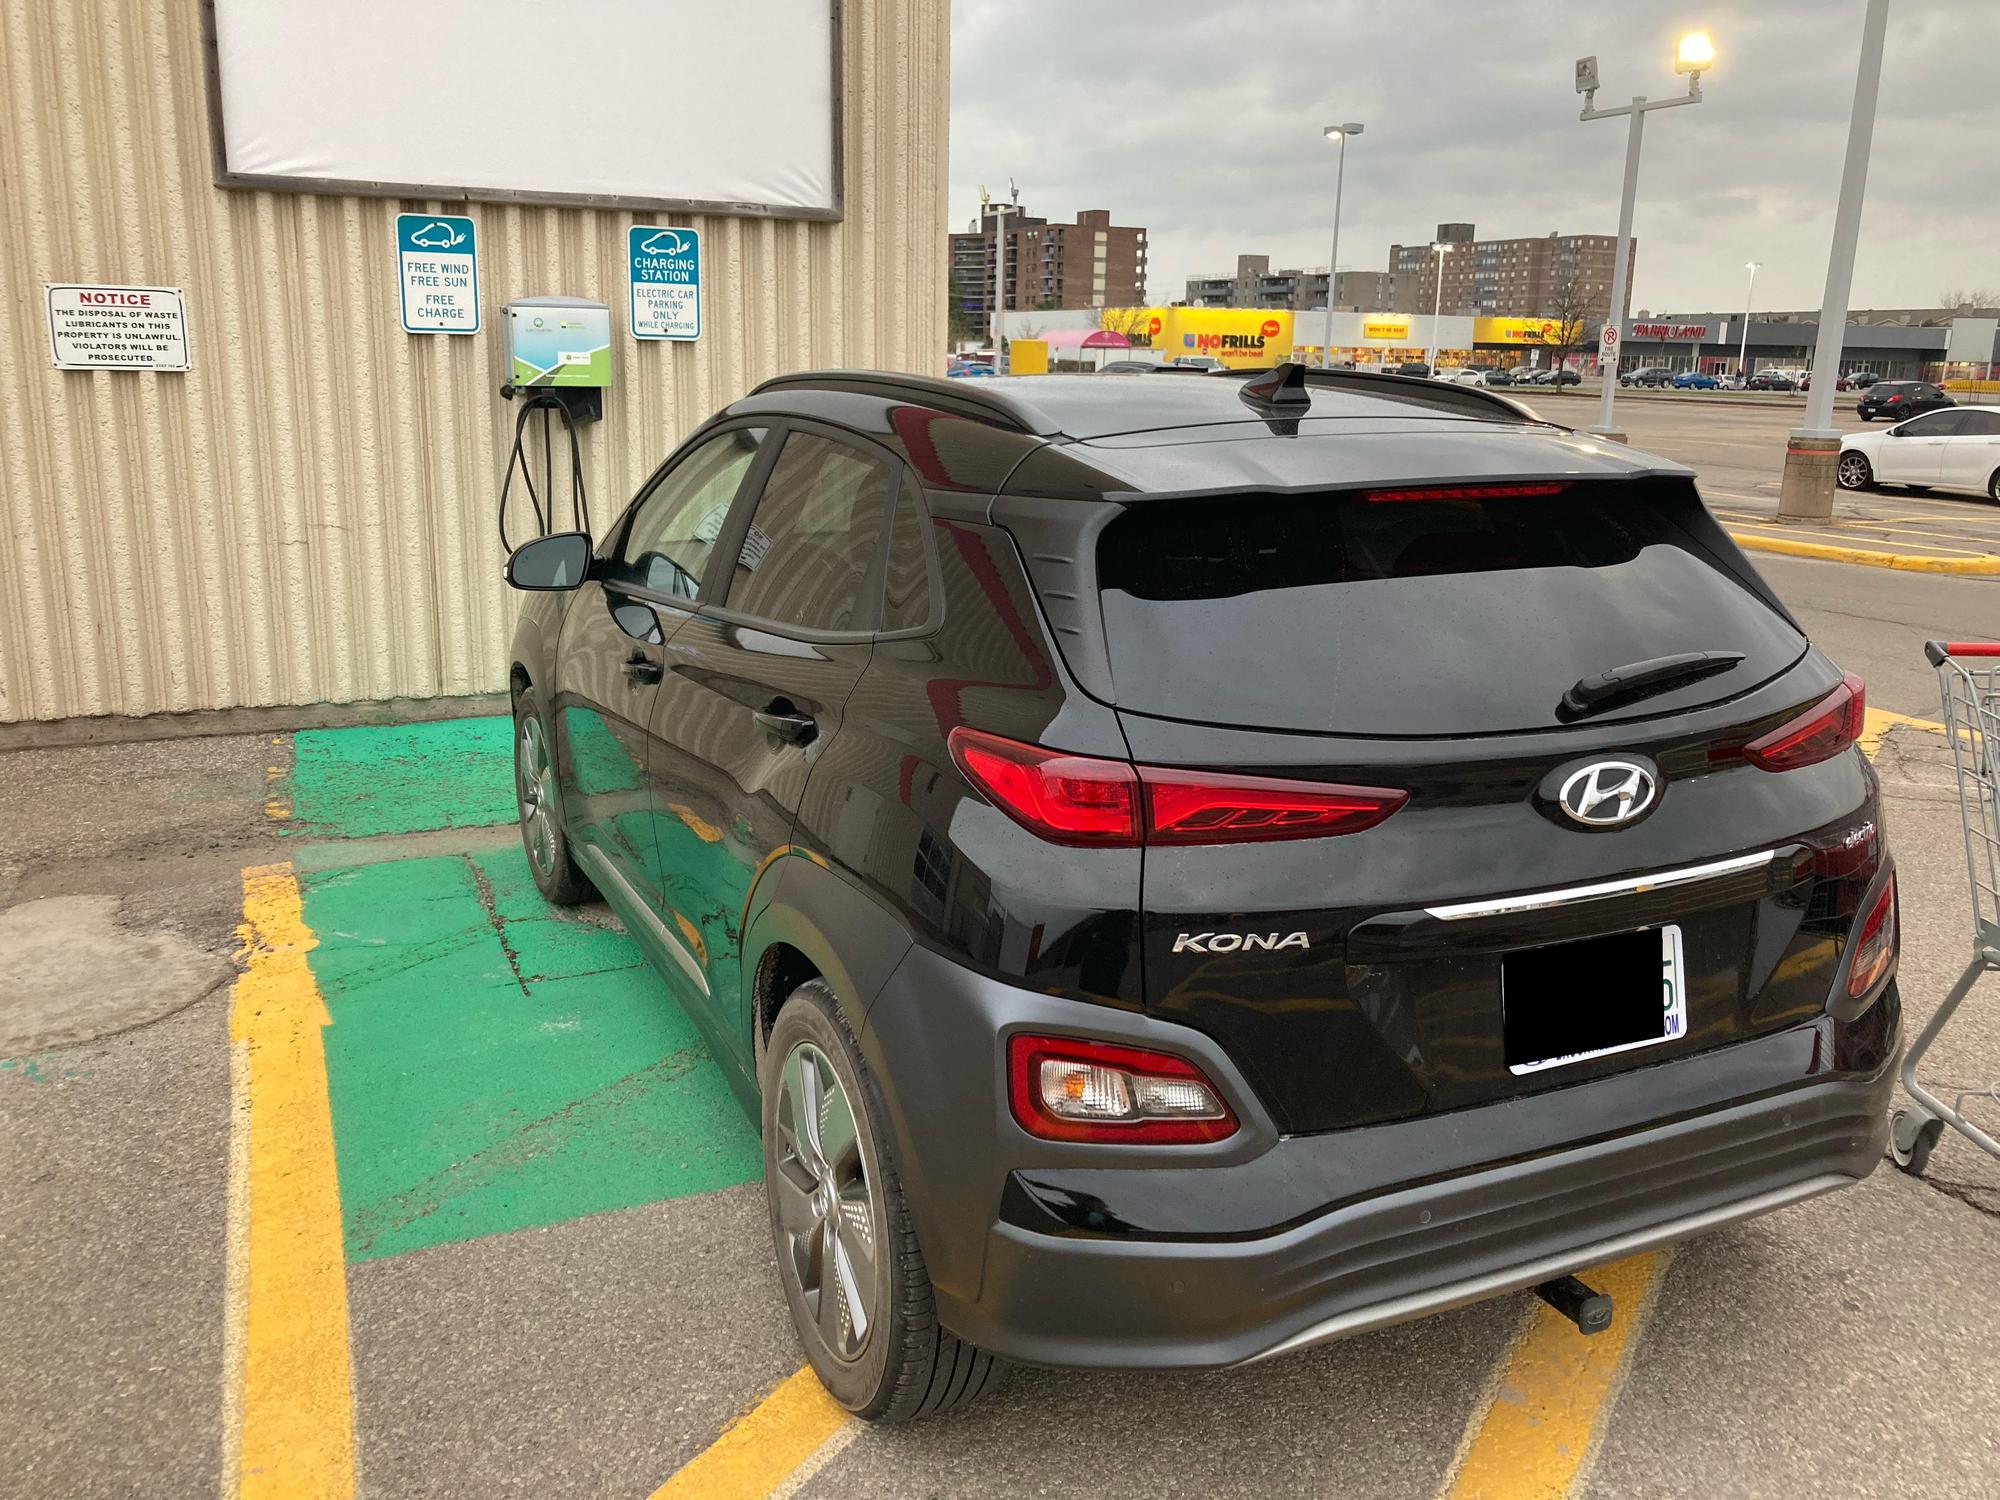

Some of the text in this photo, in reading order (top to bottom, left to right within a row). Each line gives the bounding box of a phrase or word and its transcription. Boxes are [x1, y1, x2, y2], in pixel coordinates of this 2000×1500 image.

[408, 262, 469, 274] FREE WIND
[634, 257, 695, 270] CHARGING
[642, 269, 689, 282] STATION
[411, 276, 467, 287] FREE SUN
[80, 292, 151, 305] NOTICE
[636, 289, 694, 299] ELECTRIC CAR
[426, 294, 454, 305] FREE
[648, 300, 684, 309] PARKING
[78, 310, 126, 318] DISPOSAL
[418, 308, 464, 318] CHARGE
[653, 311, 678, 320] ONLY
[66, 321, 128, 329] LUBRICANTS
[661, 321, 694, 330] CHARGING
[125, 333, 181, 341] UNLAWFUL.
[88, 354, 155, 362] PROSECUTED.
[1221, 349, 1264, 357] won't be beat
[1172, 932, 1310, 953] KONA
